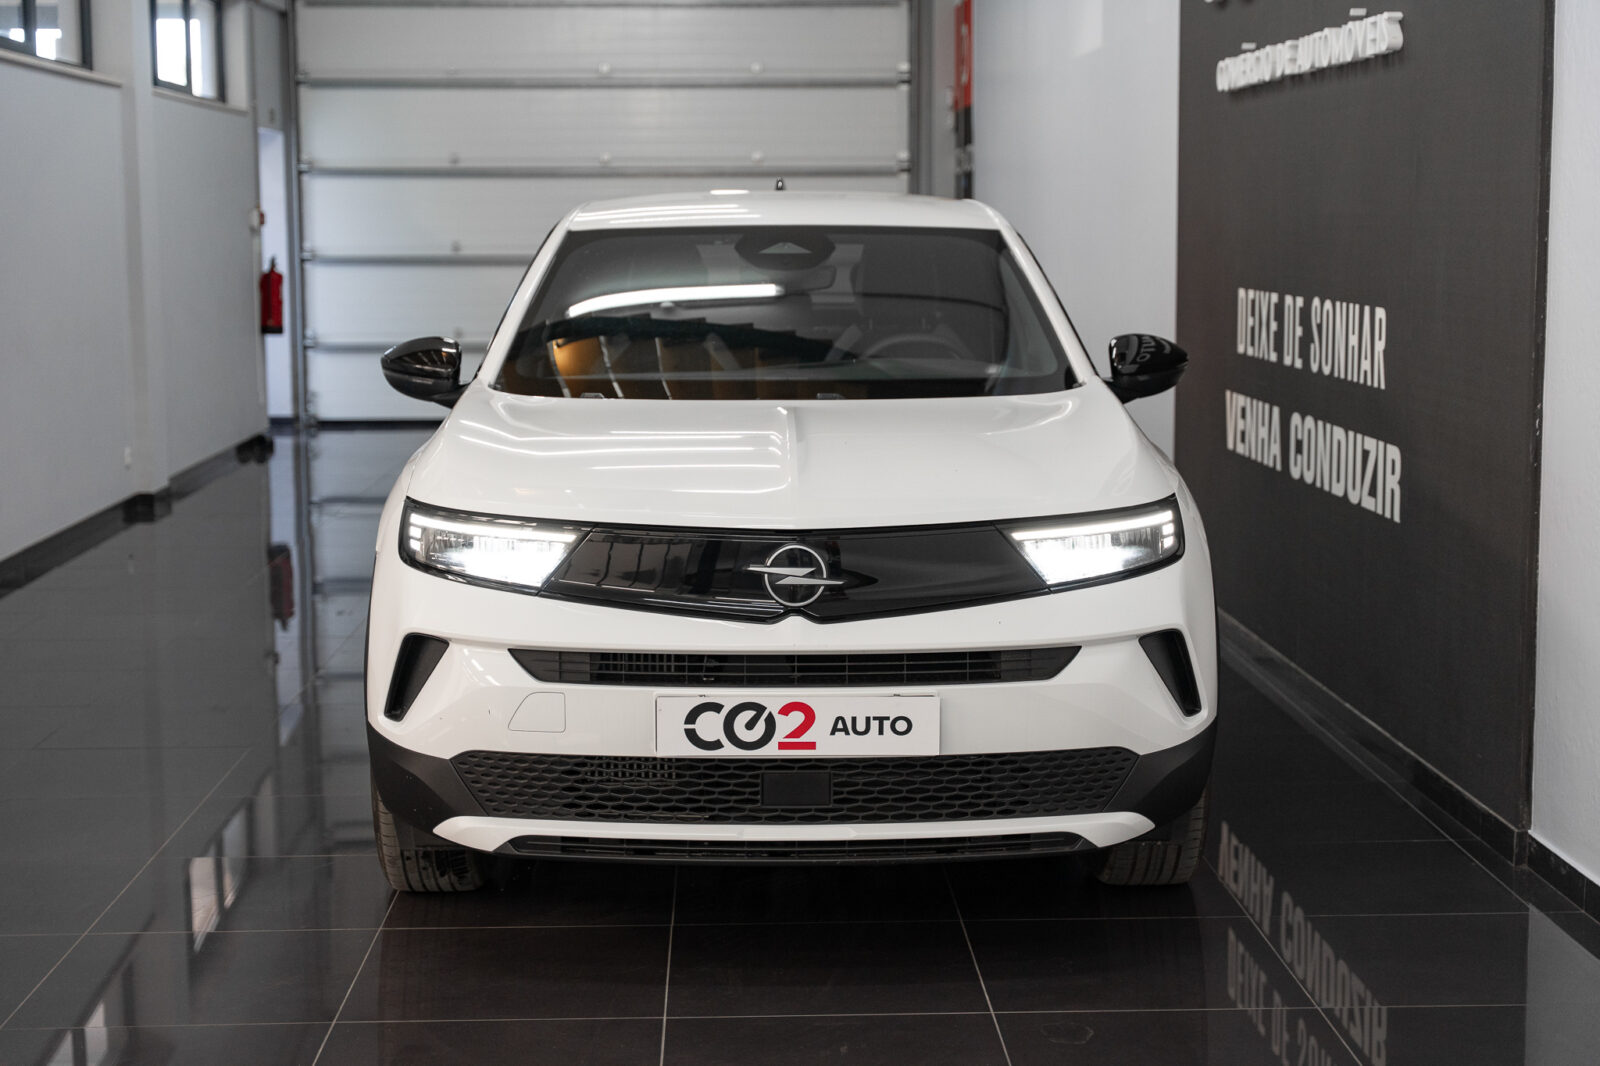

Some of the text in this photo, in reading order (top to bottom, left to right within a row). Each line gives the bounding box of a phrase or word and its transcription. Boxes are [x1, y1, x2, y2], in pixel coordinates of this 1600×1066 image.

[1237, 287, 1387, 390] DEIXE DE SONHAR
[1225, 389, 1401, 524] VENHA CONDUZIR
[684, 701, 913, 750] CO2 AUTO
